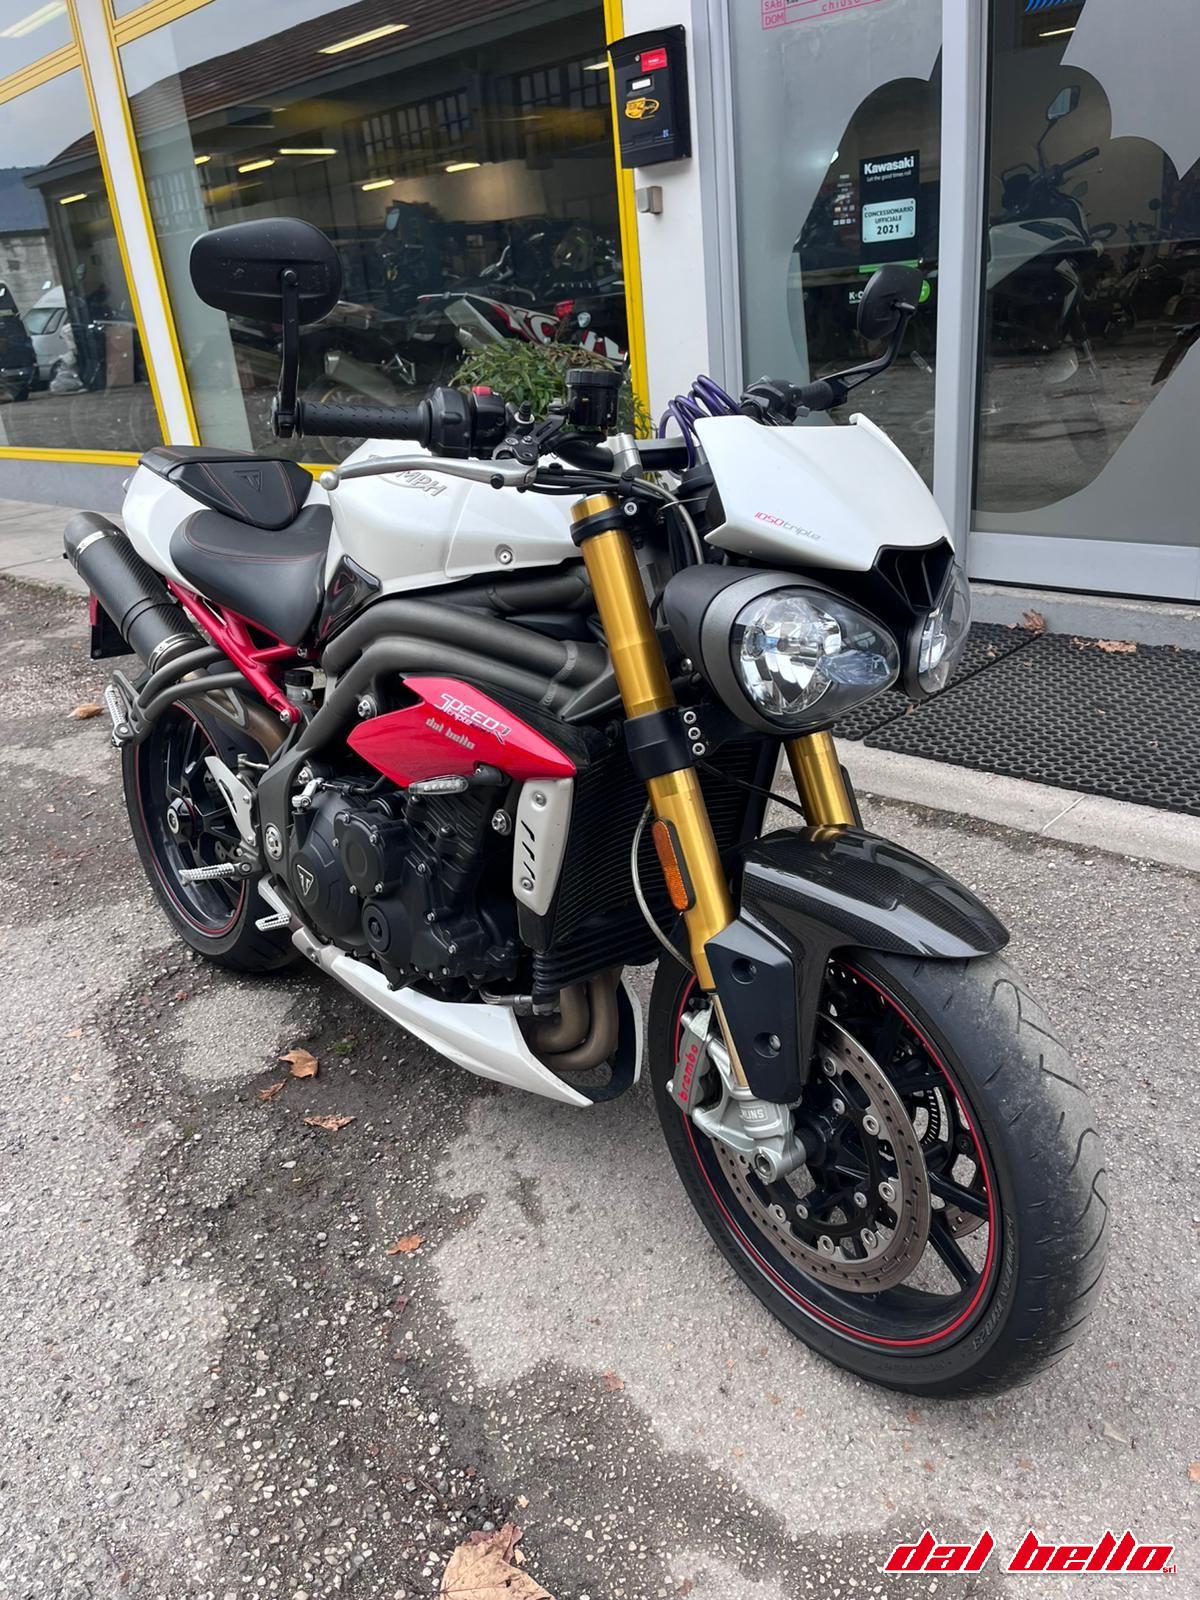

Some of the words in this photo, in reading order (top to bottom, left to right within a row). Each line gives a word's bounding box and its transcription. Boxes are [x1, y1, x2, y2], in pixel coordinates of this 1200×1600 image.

[864, 156, 914, 175] Kawasaki
[864, 206, 914, 218] CONCESSIONARIO
[875, 215, 902, 224] UFFICIALE
[877, 224, 899, 235] 2021
[425, 717, 444, 732] dal
[445, 727, 476, 750] bello
[678, 1045, 698, 1101] brembo
